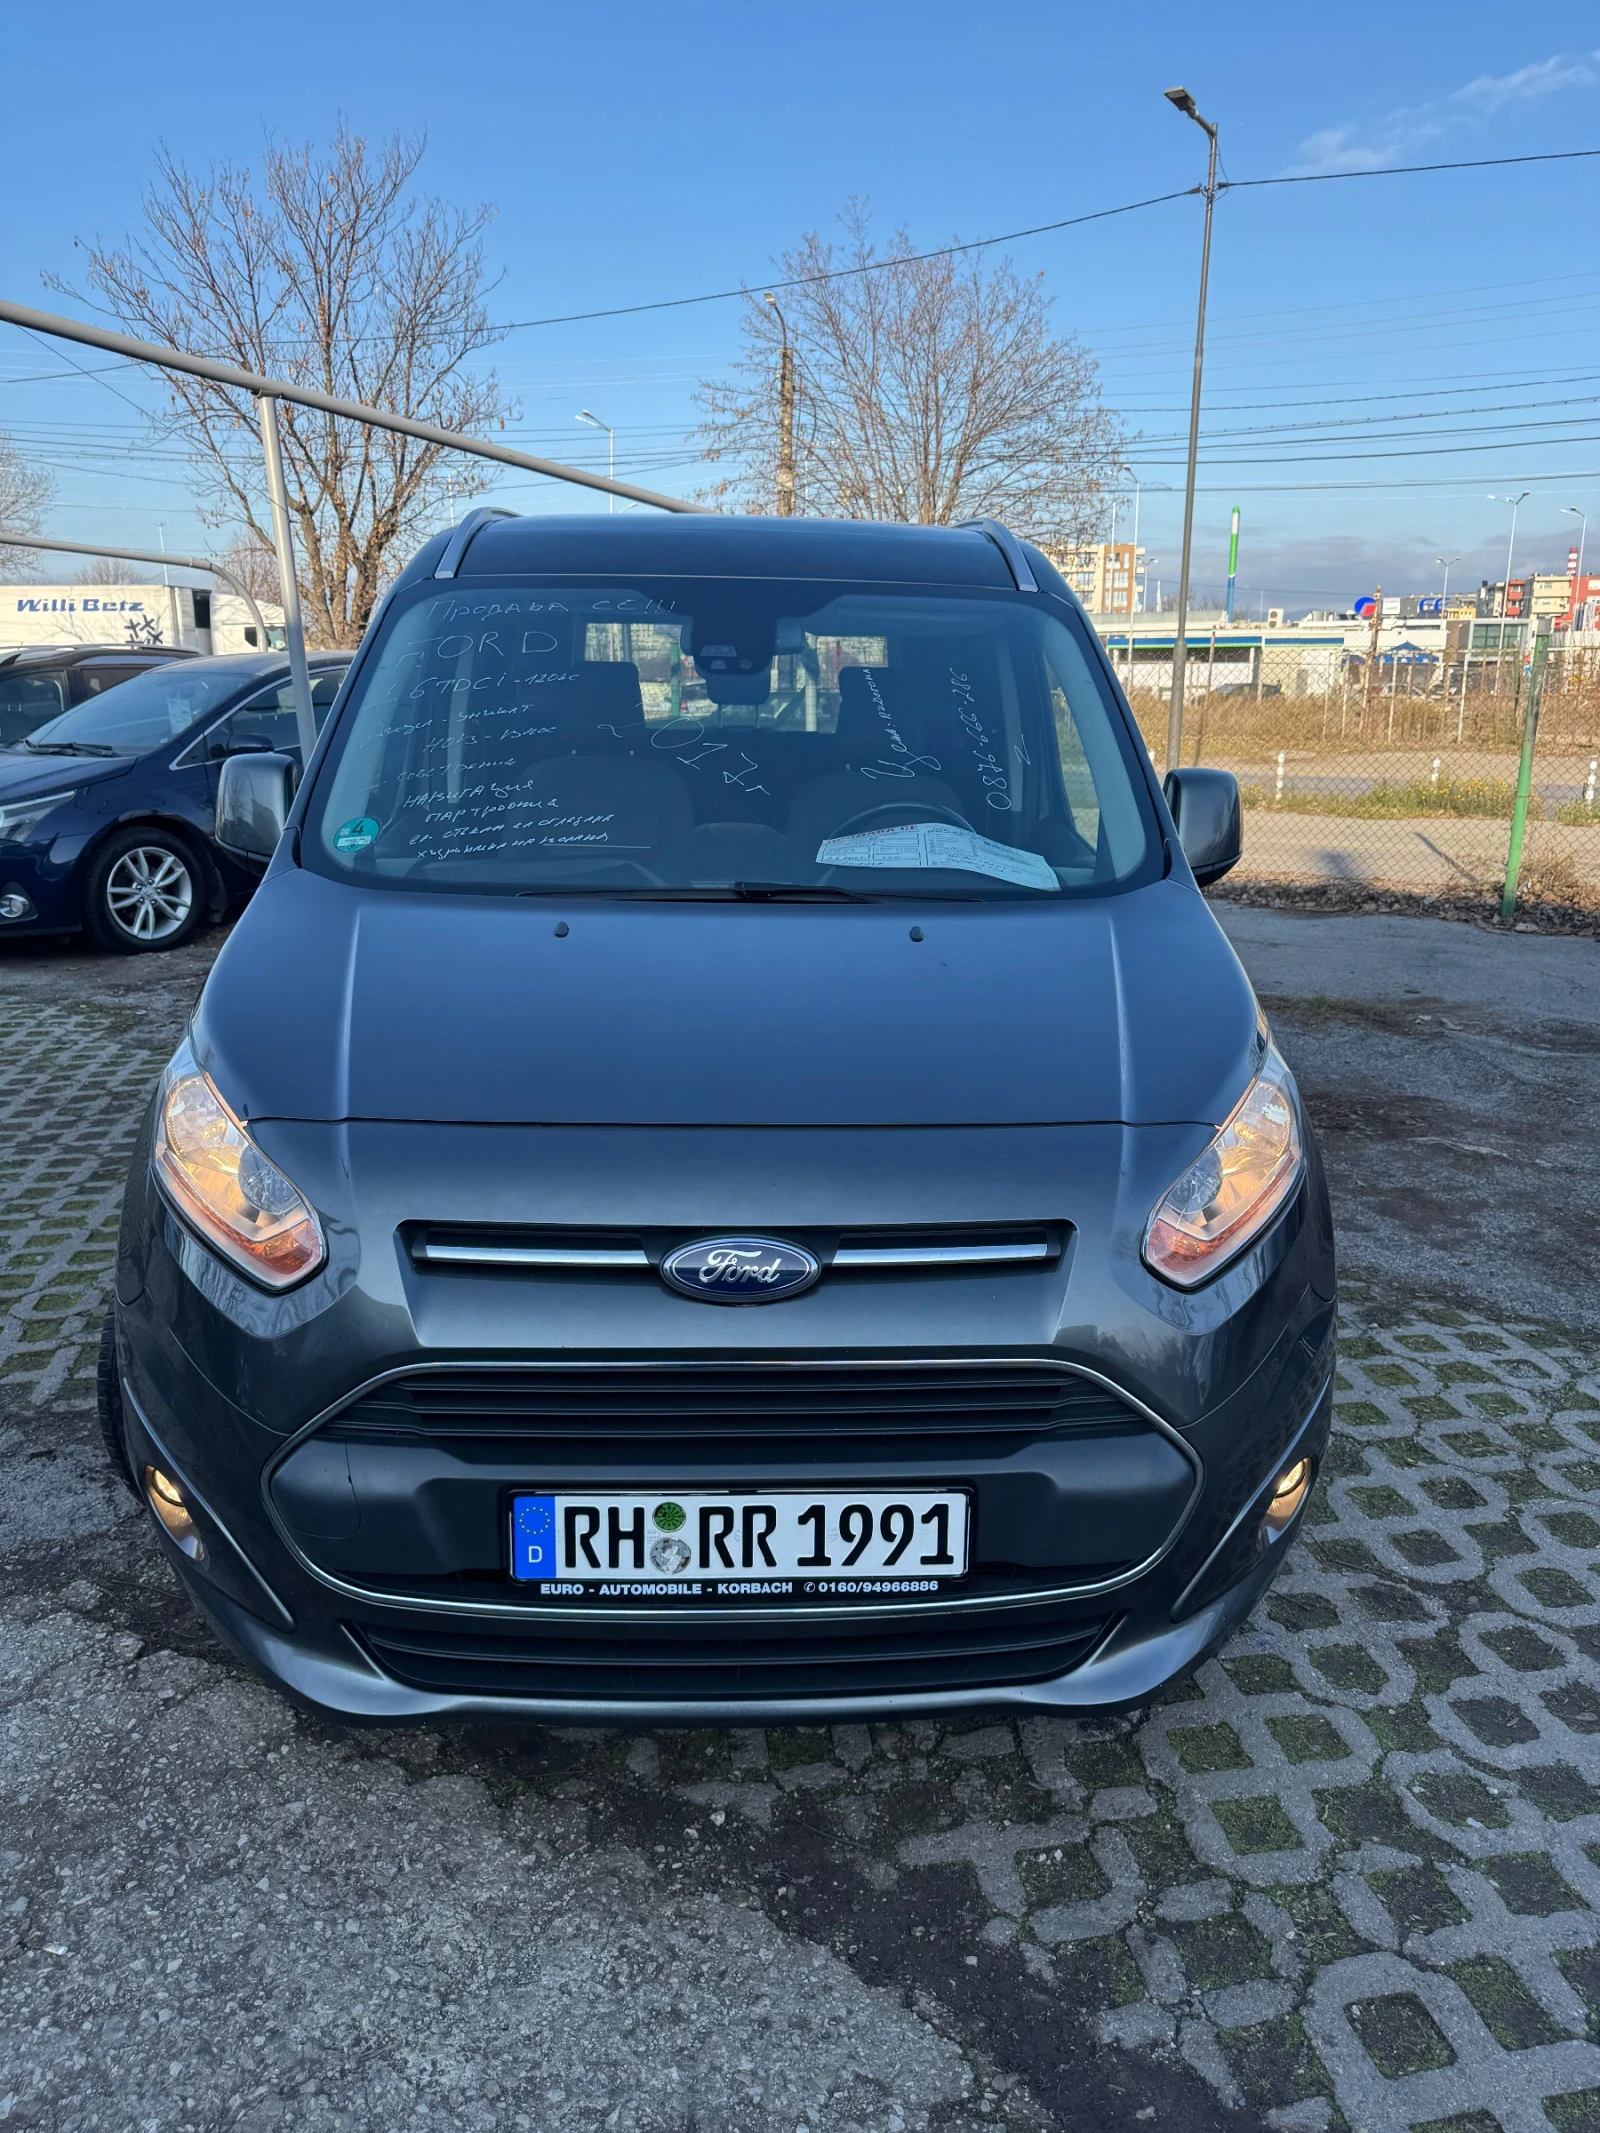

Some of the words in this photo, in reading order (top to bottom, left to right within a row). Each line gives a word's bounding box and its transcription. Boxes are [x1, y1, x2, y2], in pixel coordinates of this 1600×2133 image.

[17, 599, 77, 612] Willi
[82, 599, 145, 612] Betz
[395, 631, 558, 670] FORD
[350, 819, 365, 835] 4
[699, 1248, 782, 1284] Ford
[529, 1546, 543, 1563] D
[564, 1506, 645, 1569] RH
[698, 1505, 778, 1568] RR
[797, 1503, 955, 1567] 1991
[540, 1584, 584, 1595] EURO
[599, 1583, 702, 1595] AUTOMOBILE
[717, 1583, 793, 1594] KORBACH
[818, 1581, 938, 1593] 0160/94966886
